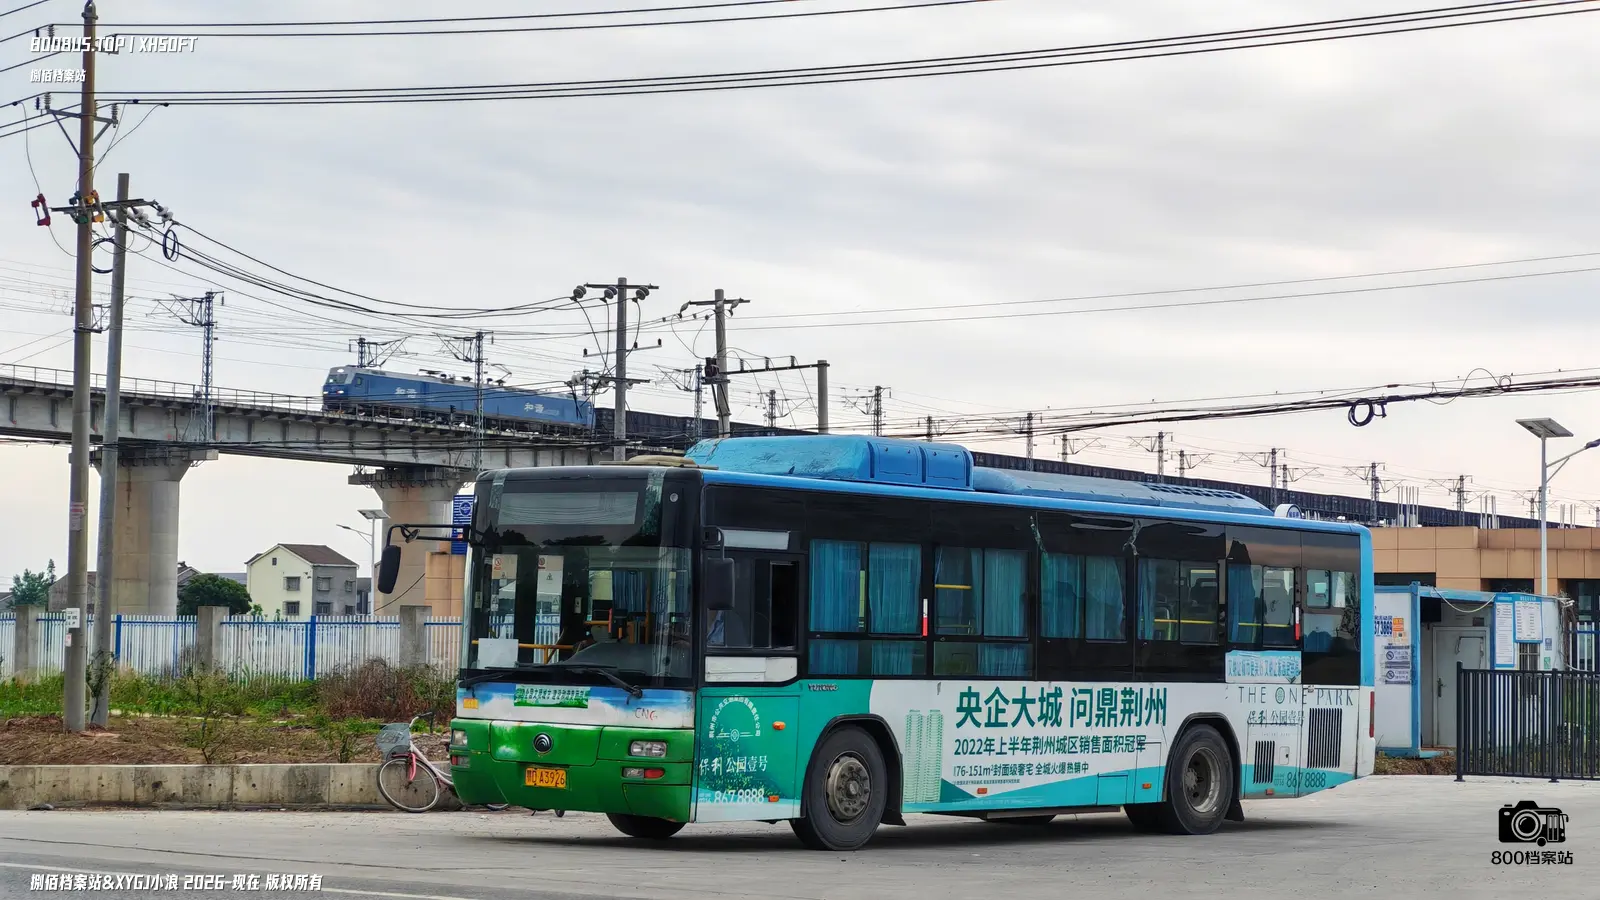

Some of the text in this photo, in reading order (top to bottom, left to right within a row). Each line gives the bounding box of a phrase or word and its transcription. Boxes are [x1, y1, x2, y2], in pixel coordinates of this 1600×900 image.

[1238, 686, 1267, 704] THE
[1316, 689, 1353, 706] PARK
[955, 686, 1167, 729] 央企大城 问鼎荆州
[954, 734, 1147, 756] 2022年上半年荆州城区销售面积冠军
[725, 755, 768, 774] 公园壹号
[1035, 761, 1089, 776] 全城火爆热销中
[1304, 771, 1327, 788] 8888
[737, 788, 765, 804] 8888
